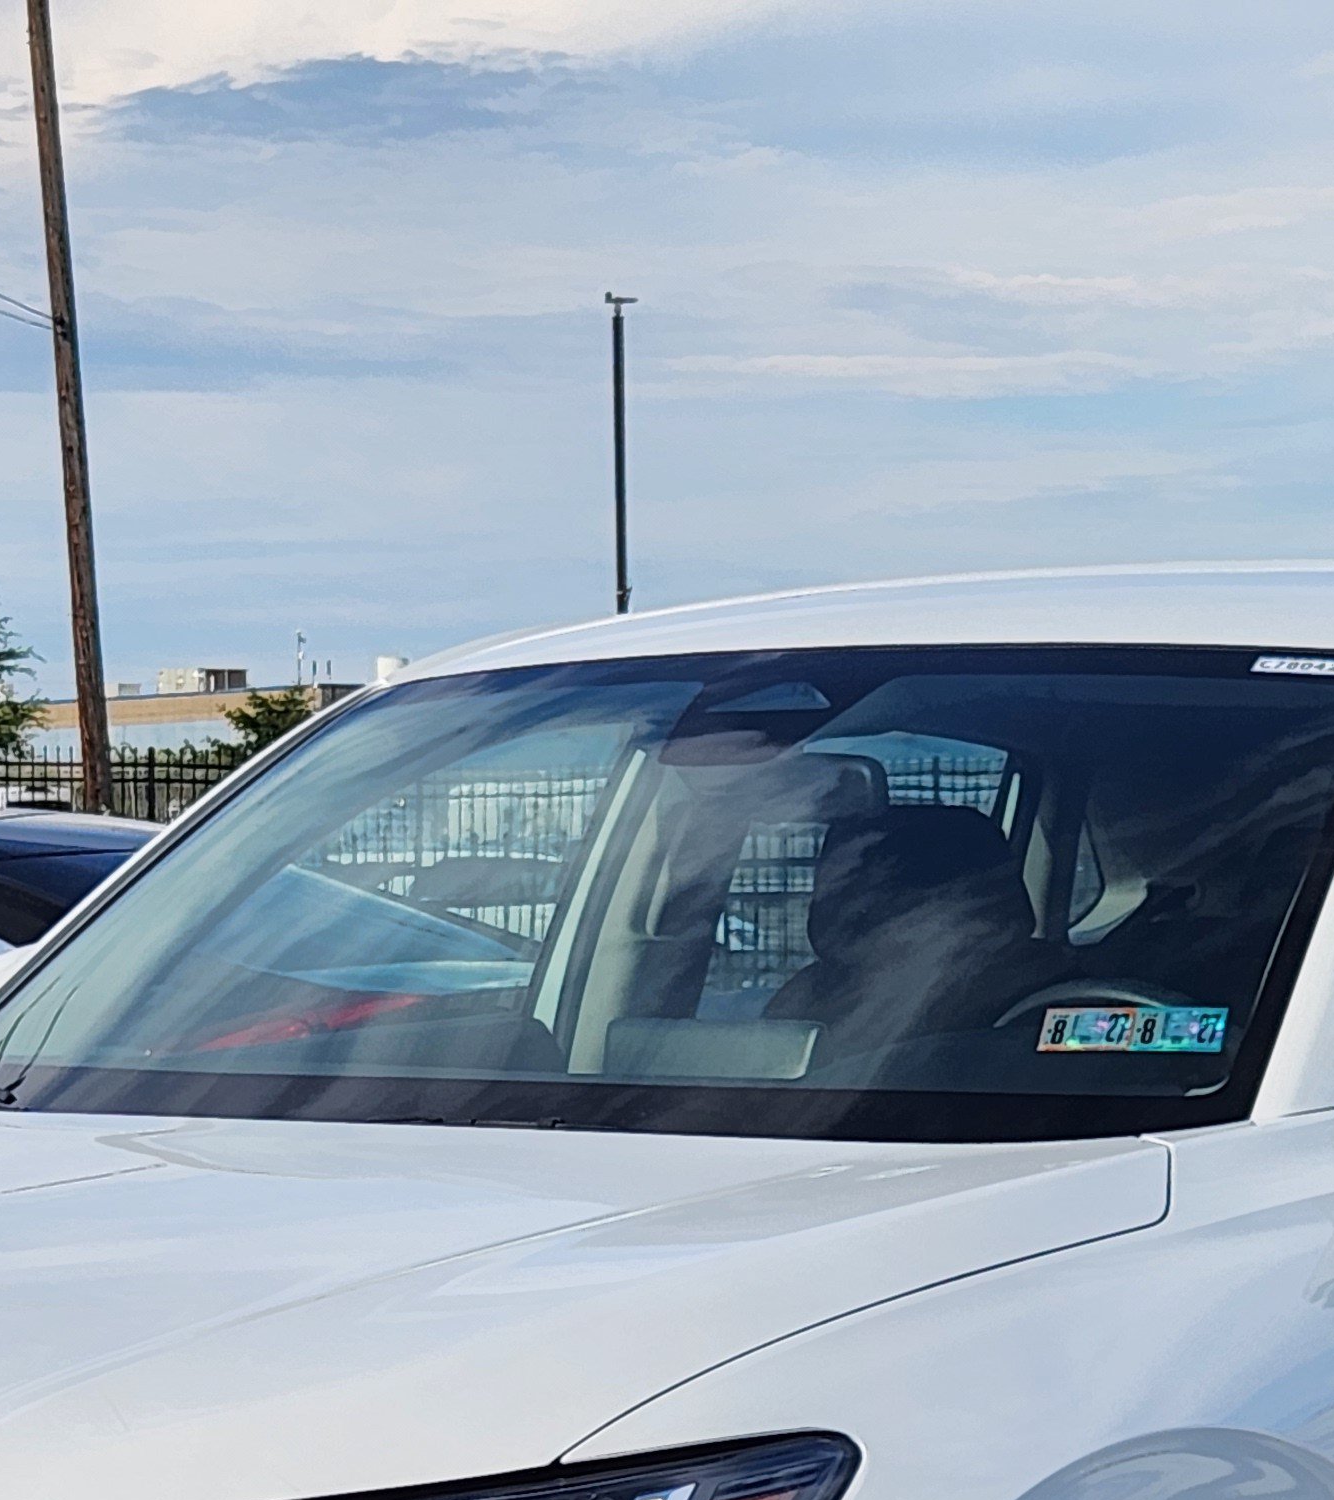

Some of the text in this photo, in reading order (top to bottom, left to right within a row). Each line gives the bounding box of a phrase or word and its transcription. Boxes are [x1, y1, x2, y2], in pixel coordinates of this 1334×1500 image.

[1050, 1013, 1130, 1044] 8 27
[1140, 1013, 1221, 1044] 8 27
